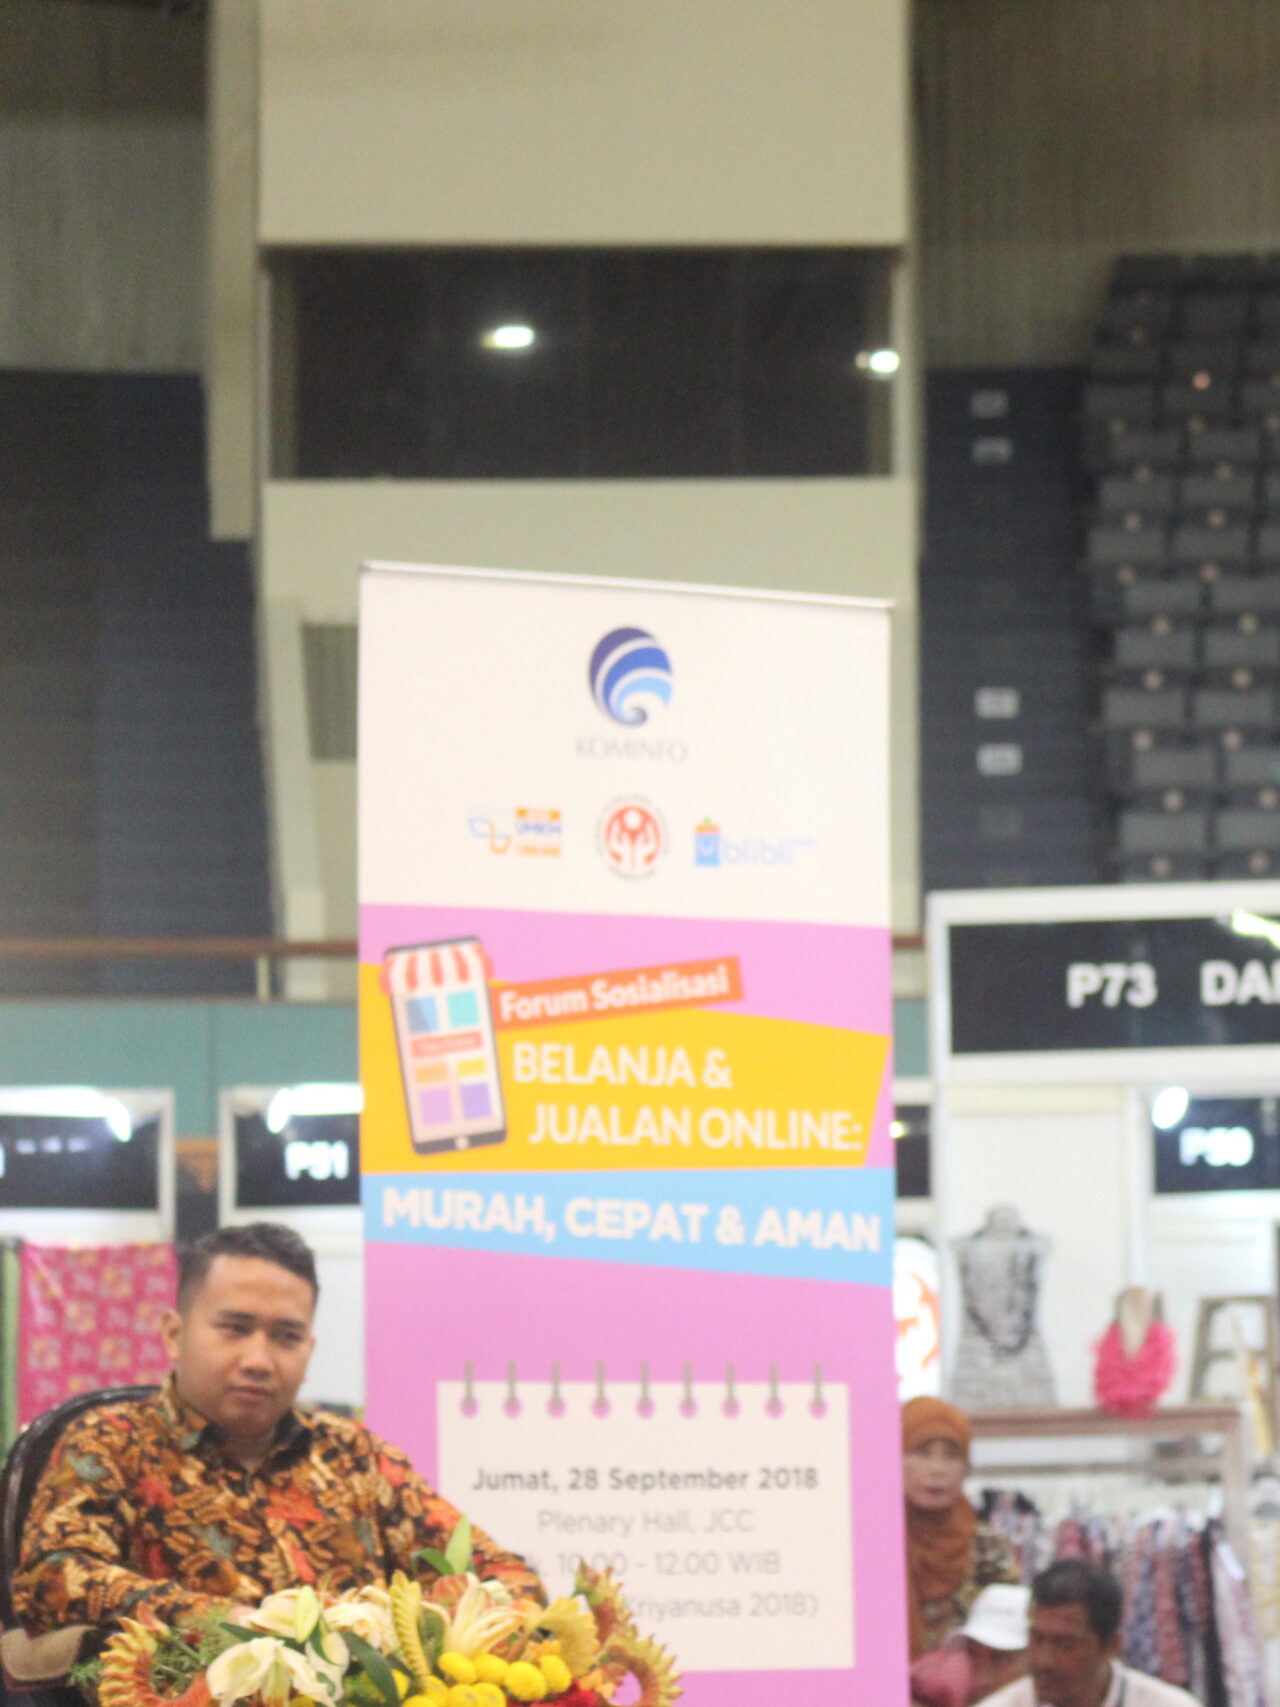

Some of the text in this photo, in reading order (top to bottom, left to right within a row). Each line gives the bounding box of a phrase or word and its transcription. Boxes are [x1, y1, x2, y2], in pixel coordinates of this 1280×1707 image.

[500, 965, 728, 1022] Forum Sosialisasi
[1067, 963, 1157, 1006] P73
[513, 1042, 696, 1088] BELANJA
[701, 1048, 734, 1089] &
[528, 1103, 863, 1152] JUALAN ONLINE:
[383, 1187, 881, 1253] MURAH, CEPAT & AMAN
[472, 1467, 820, 1497] Jumat, 28 September 2018
[538, 1508, 753, 1538] Plenary Hall, JCC
[656, 1551, 721, 1576] 12.00
[730, 1551, 782, 1576] WIB
[750, 1592, 820, 1620] 2018)
